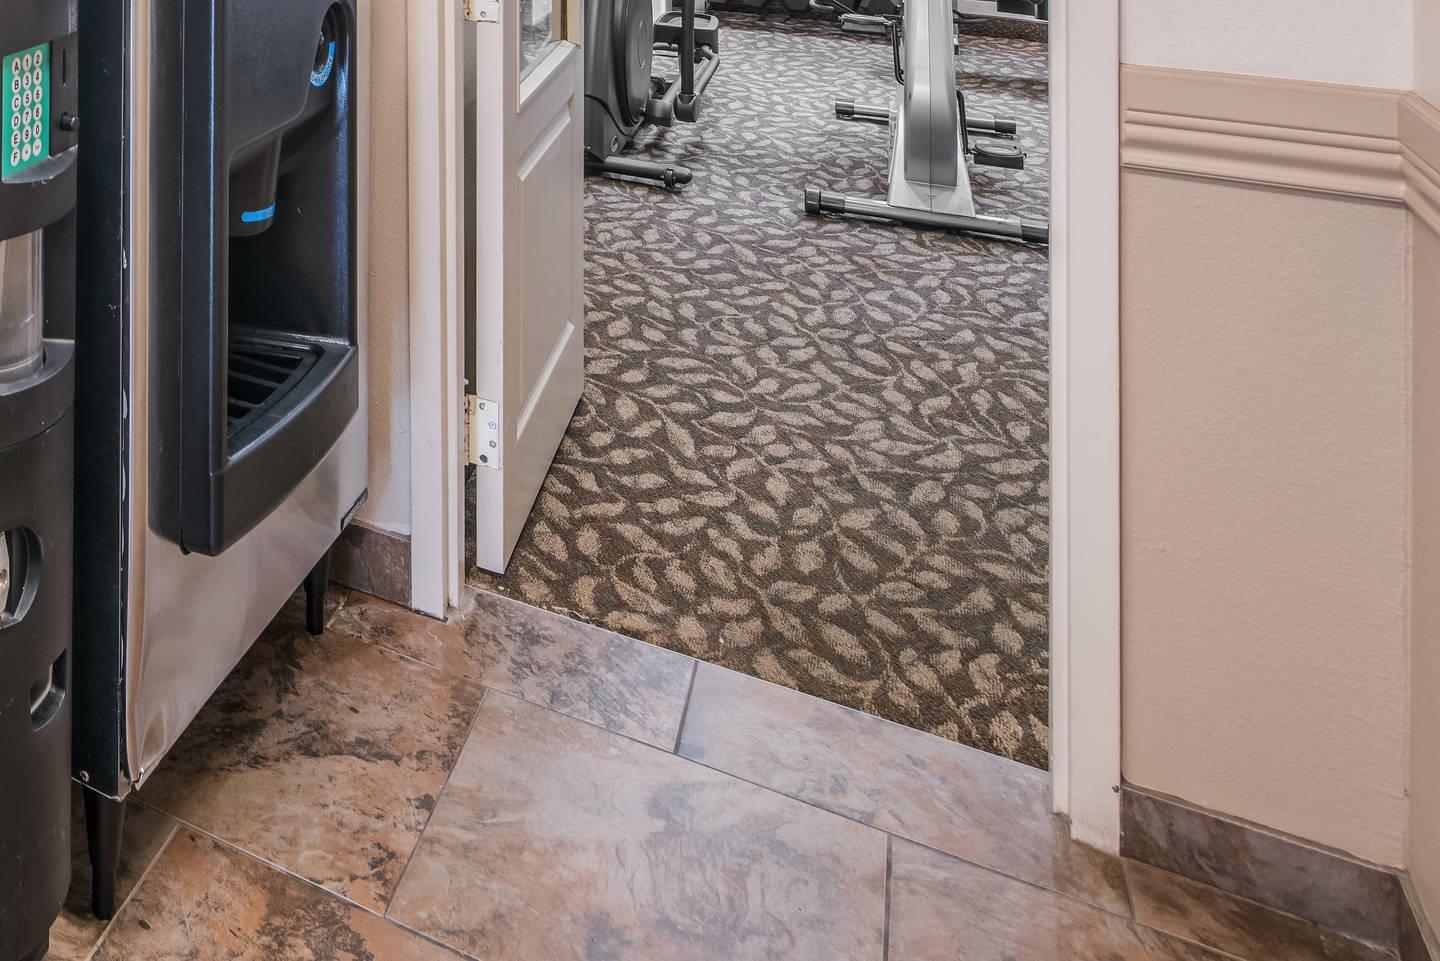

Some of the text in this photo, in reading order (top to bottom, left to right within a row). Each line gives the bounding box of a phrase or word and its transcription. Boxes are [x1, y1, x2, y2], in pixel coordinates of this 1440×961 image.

[25, 57, 29, 67] 1
[35, 54, 40, 64] 2
[14, 62, 19, 71] A
[14, 79, 19, 90] B
[25, 75, 29, 86] 3
[25, 93, 30, 104] 5
[35, 89, 40, 100] 6
[14, 97, 19, 108] C
[25, 111, 30, 122] 7
[35, 107, 40, 117] 8
[14, 116, 19, 127] D
[25, 129, 29, 140] 9
[35, 124, 40, 135] 0
[14, 135, 18, 145] E
[13, 153, 18, 163] F
